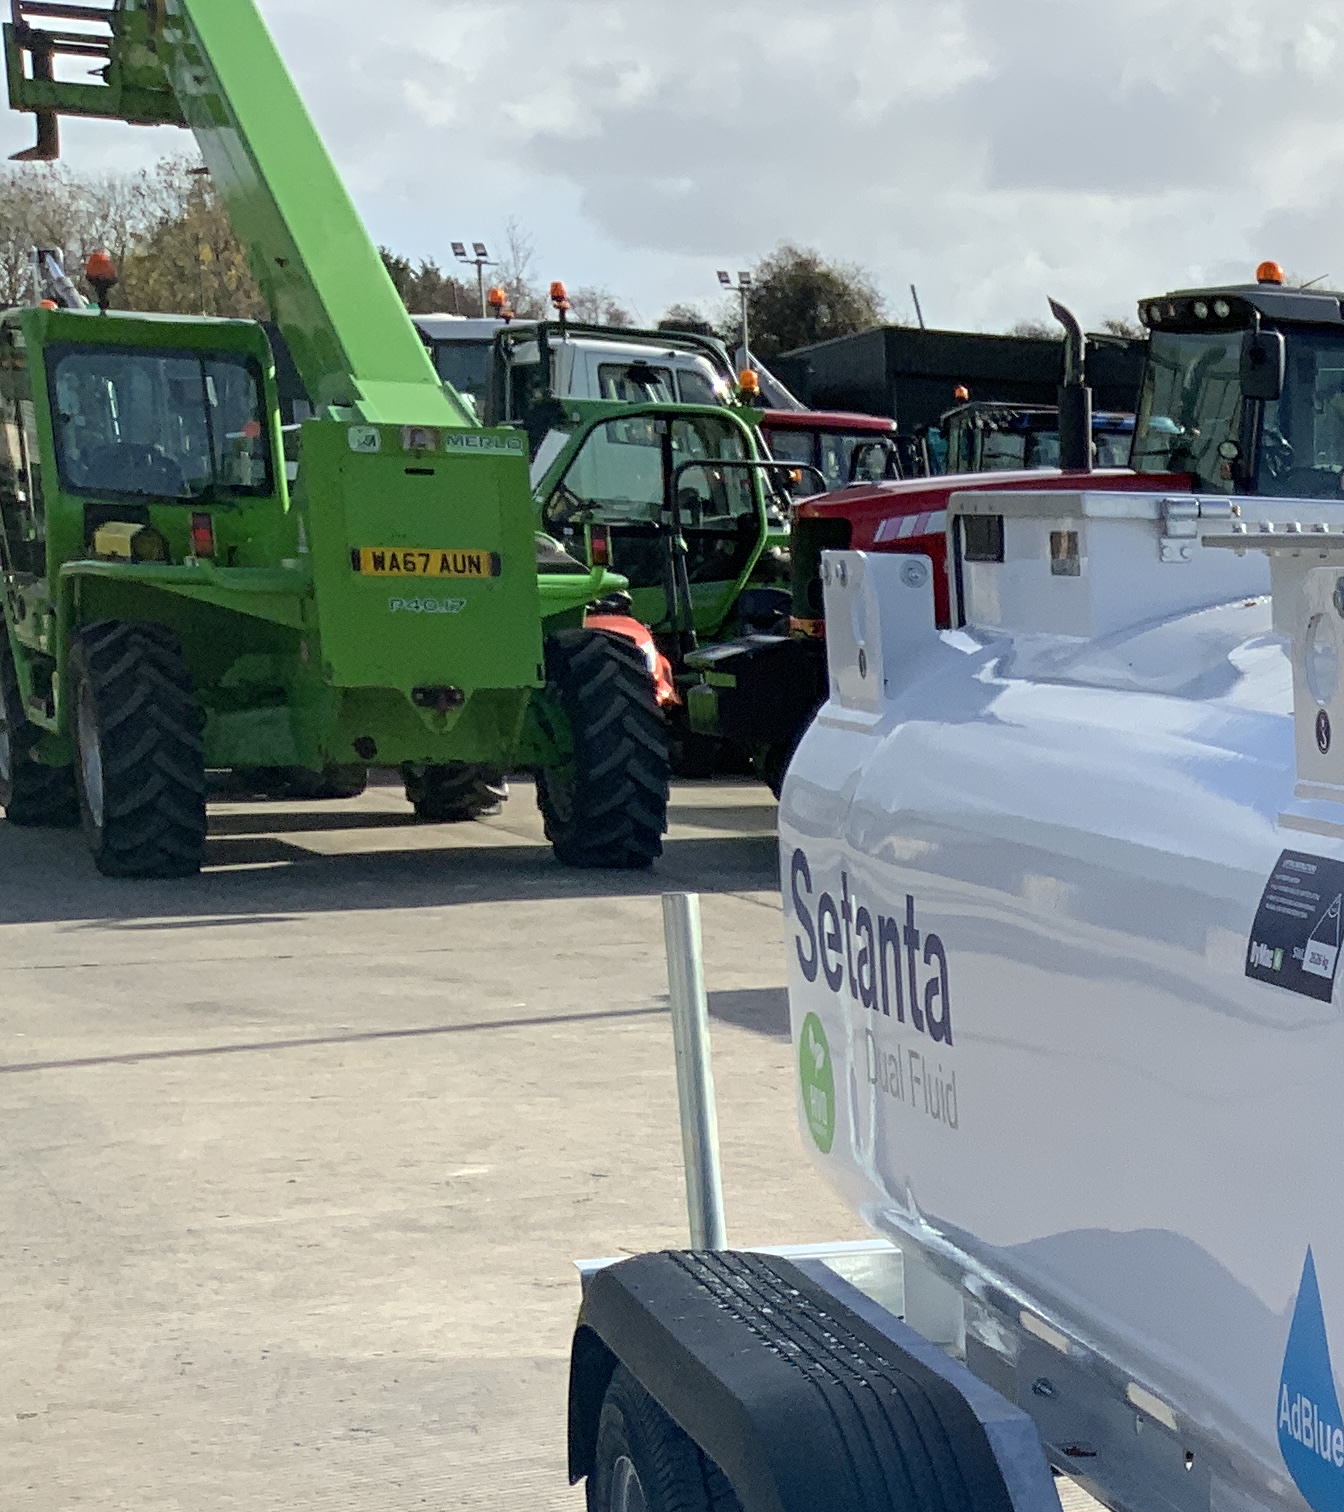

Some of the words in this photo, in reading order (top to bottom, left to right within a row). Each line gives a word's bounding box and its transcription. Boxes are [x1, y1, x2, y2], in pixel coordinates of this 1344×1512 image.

[371, 550, 431, 574] WA67
[439, 553, 482, 575] AUN
[791, 848, 953, 1047] Setanta
[865, 1028, 905, 1102] Dual
[908, 1049, 958, 1129] Fluid
[1279, 1383, 1344, 1468] AdBlue
